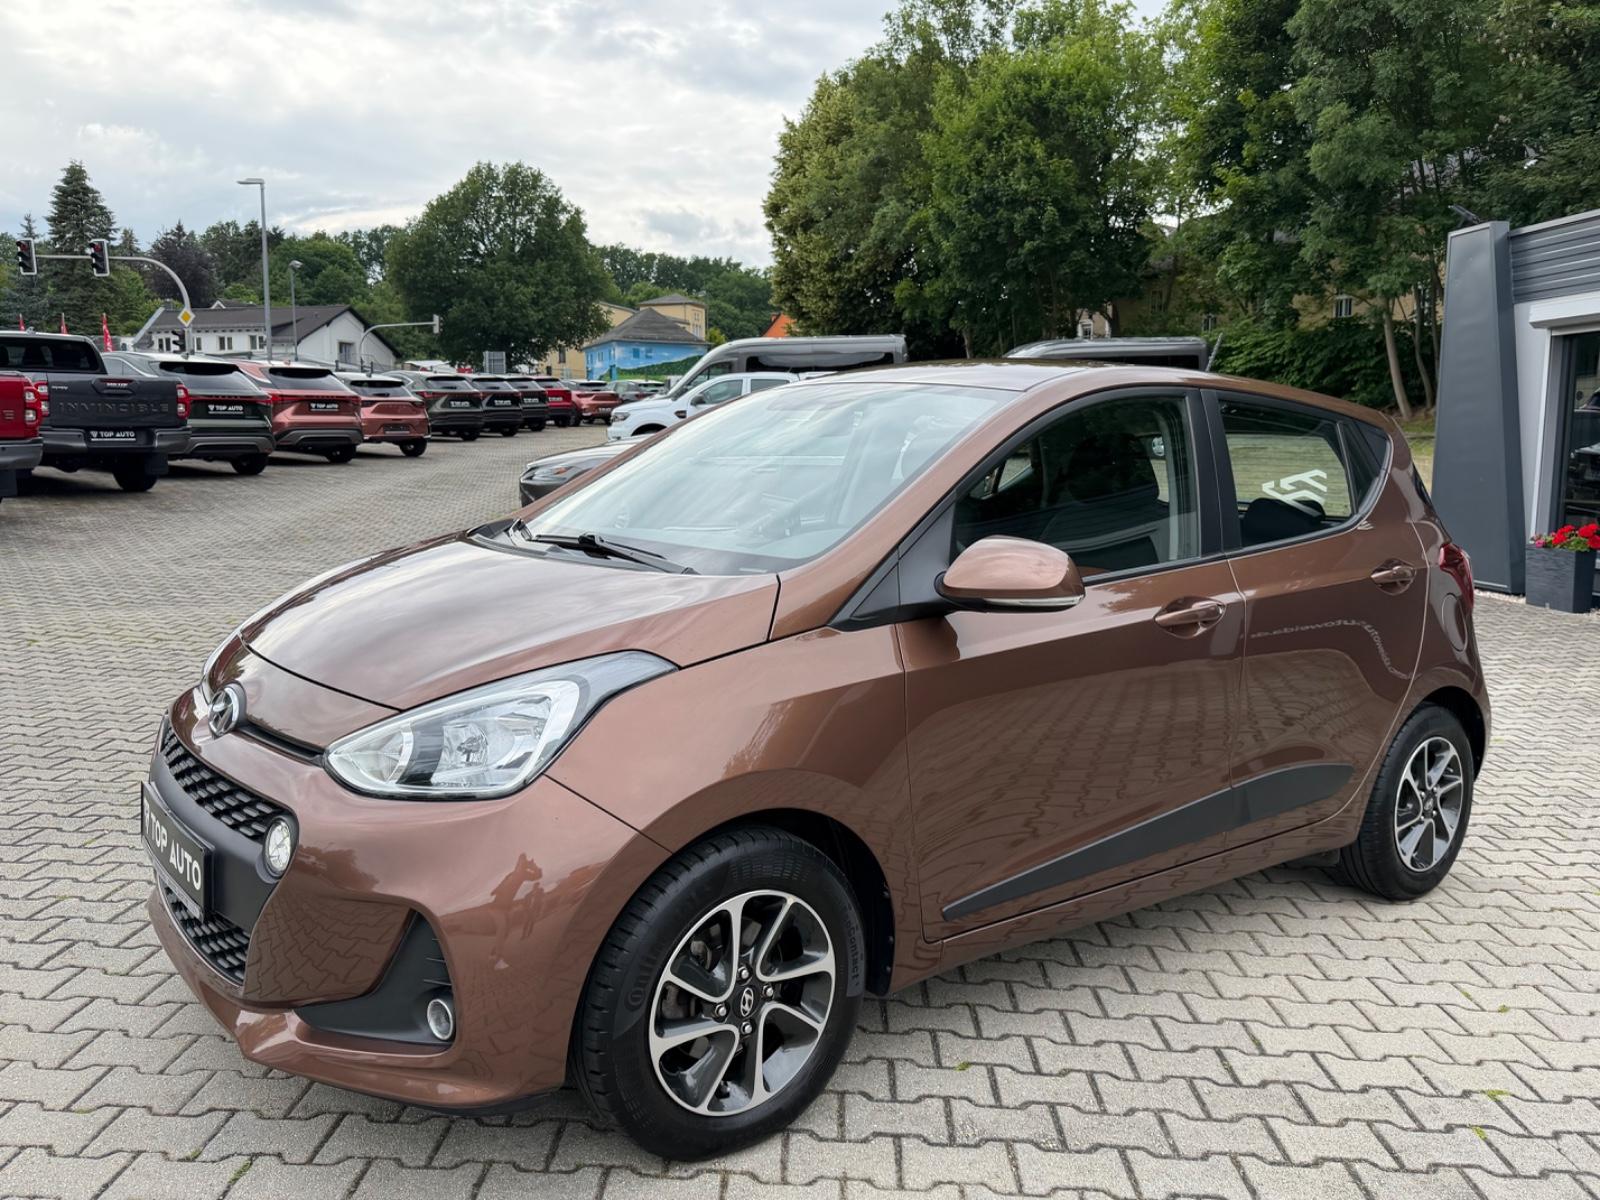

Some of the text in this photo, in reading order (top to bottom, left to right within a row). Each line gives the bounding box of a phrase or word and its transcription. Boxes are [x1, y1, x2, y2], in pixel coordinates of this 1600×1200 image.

[59, 402, 169, 413] INVINCIBLE
[150, 811, 167, 852] TOP
[170, 840, 202, 890] AUTO
